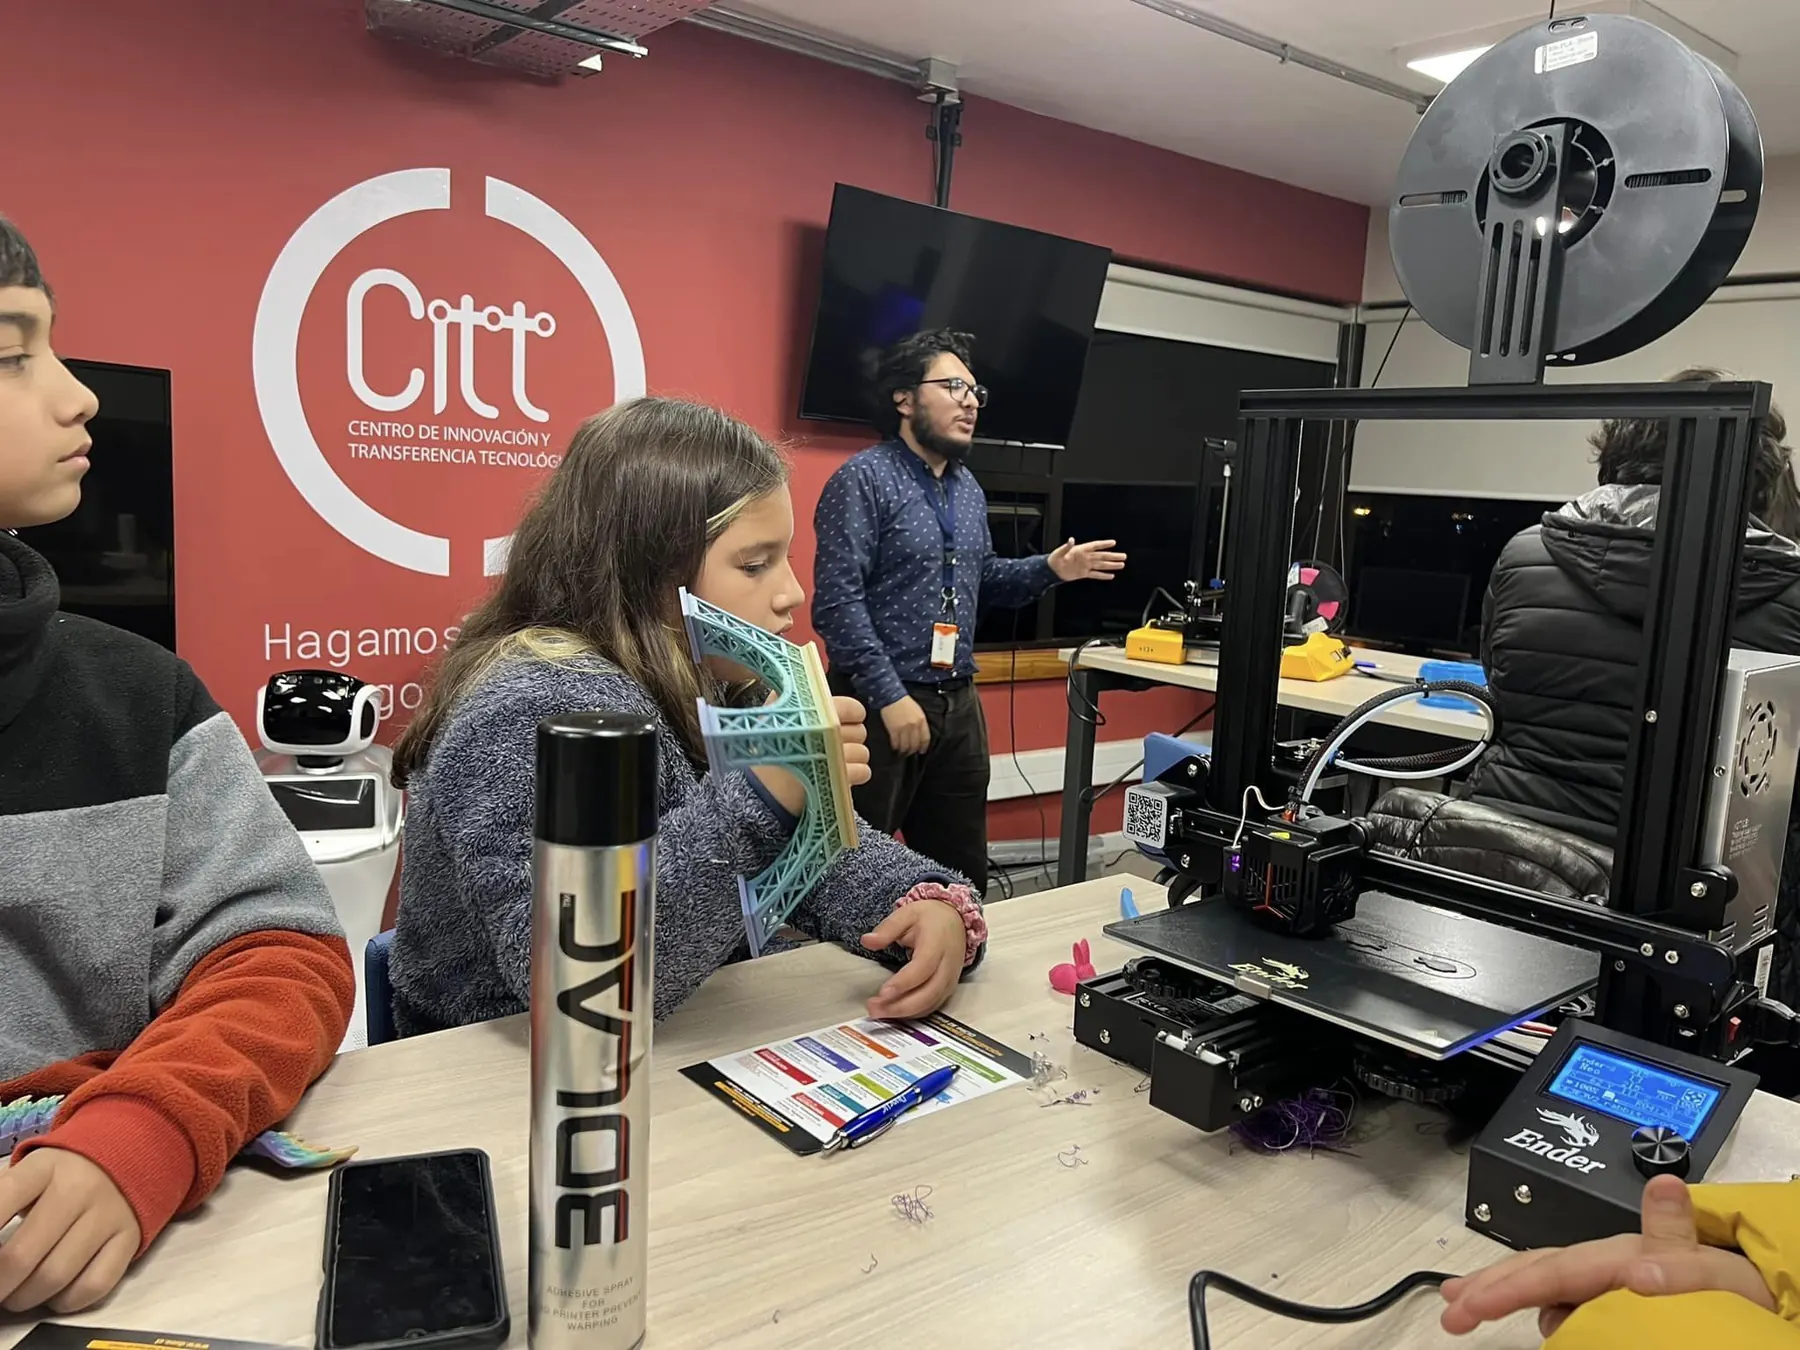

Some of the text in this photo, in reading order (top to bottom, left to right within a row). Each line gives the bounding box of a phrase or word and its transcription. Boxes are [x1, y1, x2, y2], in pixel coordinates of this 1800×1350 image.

[348, 420, 551, 446] CENTRO DE INNOVACIÓN Y
[348, 443, 476, 464] TRANSFERENCIA
[264, 623, 461, 667] Hagamos
[1502, 1128, 1606, 1174] Ender
[547, 1285, 600, 1298] ADHESIVE
[582, 1298, 605, 1309] FOR
[552, 1307, 600, 1320] PRINTER
[567, 1315, 618, 1331] WARPING
